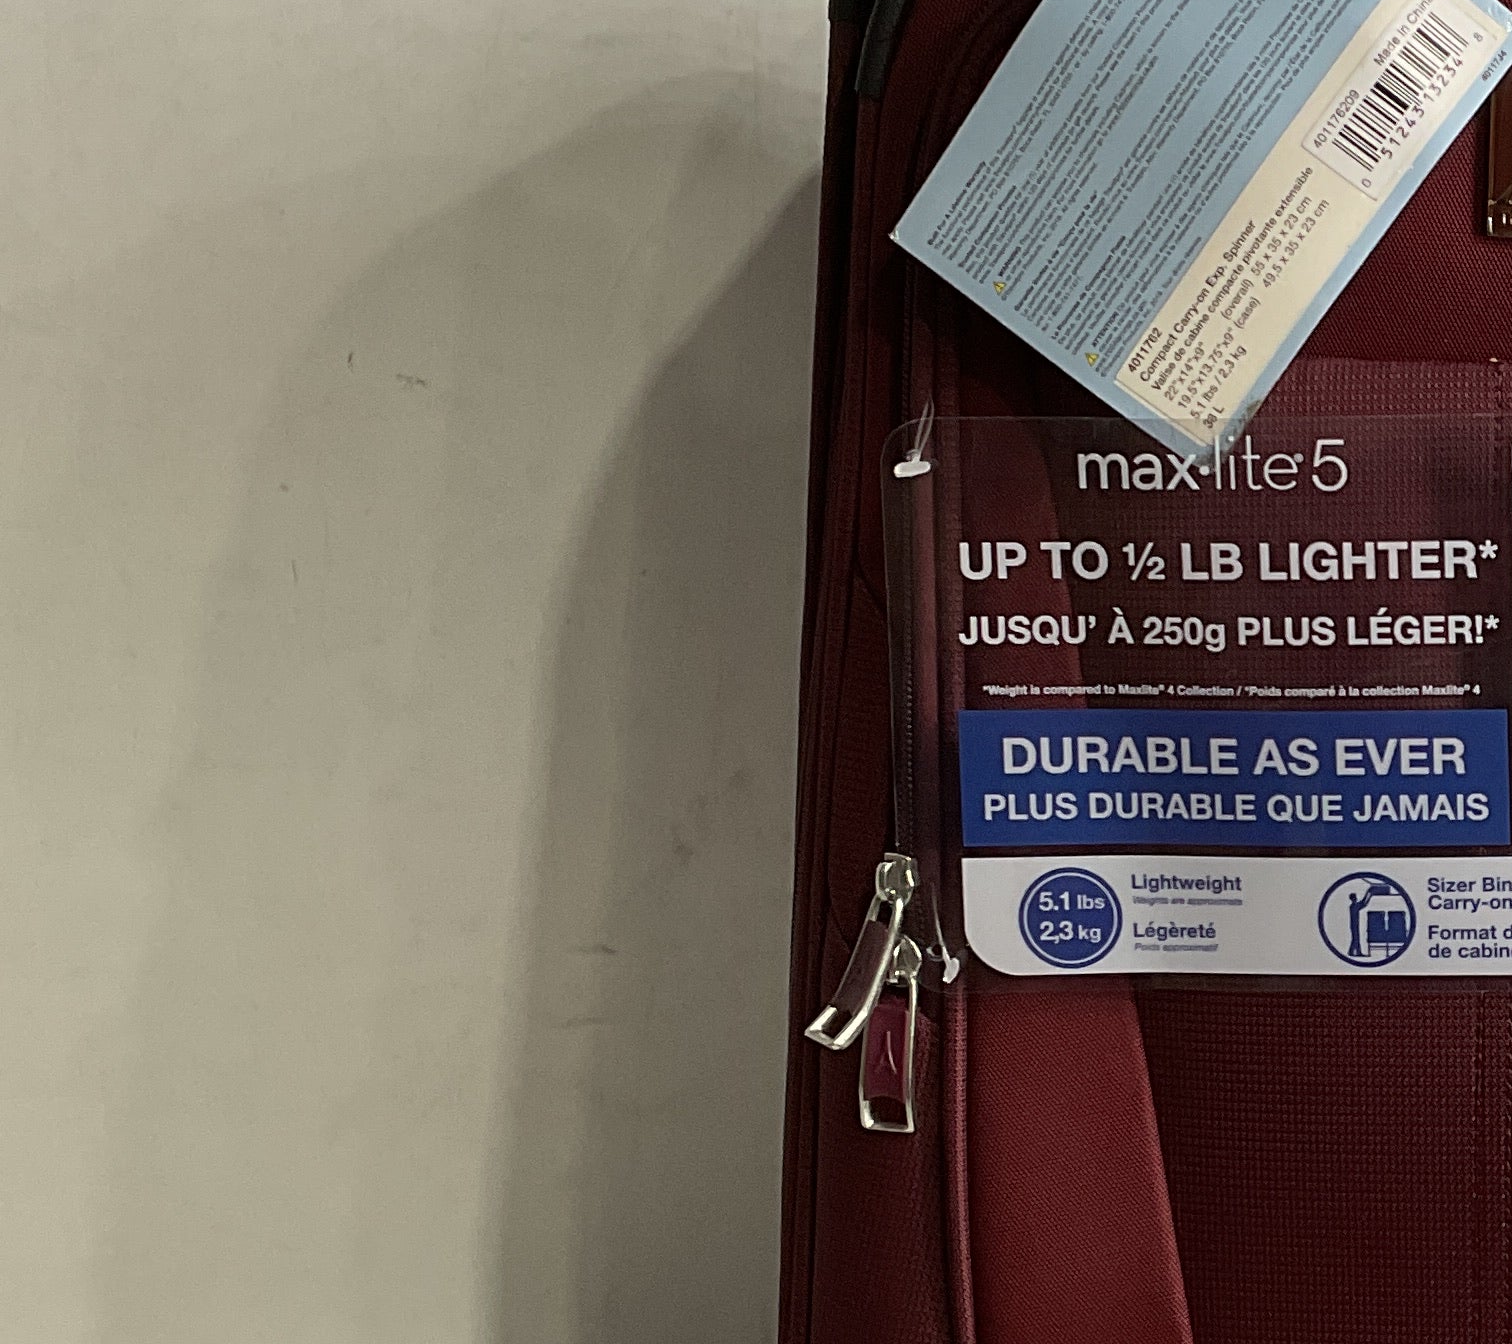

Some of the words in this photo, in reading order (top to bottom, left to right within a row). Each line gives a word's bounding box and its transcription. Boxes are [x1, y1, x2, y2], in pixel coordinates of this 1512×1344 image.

[1311, 87, 1360, 149] 401176209
[1373, 33, 1402, 67] Made
[1378, 102, 1427, 160] 51243
[1422, 54, 1465, 105] 13234
[1471, 30, 1485, 43] 8
[1219, 277, 1254, 320] (overall)
[1249, 259, 1266, 276] 55
[1283, 212, 1299, 230] 23
[1295, 195, 1312, 215] cm
[1150, 359, 1176, 391] Valise
[1170, 345, 1186, 361] de
[1182, 311, 1211, 347] cabine
[1205, 262, 1245, 314] compacte
[1239, 215, 1278, 264] pivotante
[1272, 164, 1313, 217] extensible
[1137, 332, 1178, 383] Compact
[1173, 286, 1211, 335] Carry-on
[1204, 260, 1228, 288] Exp.
[1222, 218, 1258, 263] Spinner
[1233, 296, 1262, 330] (case)
[1229, 343, 1247, 361] kg
[1312, 439, 1348, 491] 5
[959, 542, 1027, 580] UP
[1040, 541, 1108, 580] TO
[1181, 542, 1243, 581] LB
[1108, 607, 1135, 644] À
[1143, 617, 1226, 652] 250g
[1238, 616, 1336, 646] PLUS
[1031, 685, 1040, 694] is
[1043, 685, 1101, 696] compared
[1104, 685, 1115, 694] to
[1167, 685, 1174, 694] 4
[1177, 685, 1234, 696] Collection
[1284, 685, 1335, 698] comparé
[1338, 685, 1346, 696] à
[1349, 685, 1359, 696] la
[1362, 685, 1419, 696] collection
[1472, 685, 1480, 695] 4
[1003, 737, 1239, 775] DURABLE
[1253, 738, 1319, 776] AS
[1335, 738, 1466, 775] EVER
[984, 793, 1078, 820] PLUS
[1089, 792, 1257, 821] DURABLE
[1267, 795, 1343, 822] QUE
[1353, 793, 1489, 821] JAMAIS
[1131, 874, 1242, 894] Lightweight
[1427, 877, 1476, 892] Sizer
[1482, 877, 1512, 892] Bin
[1039, 891, 1070, 911] 5.1
[1077, 895, 1105, 909] lbs
[1428, 895, 1512, 913] Carry-on
[1040, 921, 1073, 943] 2,3
[1078, 925, 1101, 942] kg
[1133, 922, 1216, 941] Légèreté
[1428, 925, 1497, 940] Format
[1428, 944, 1451, 958] de
